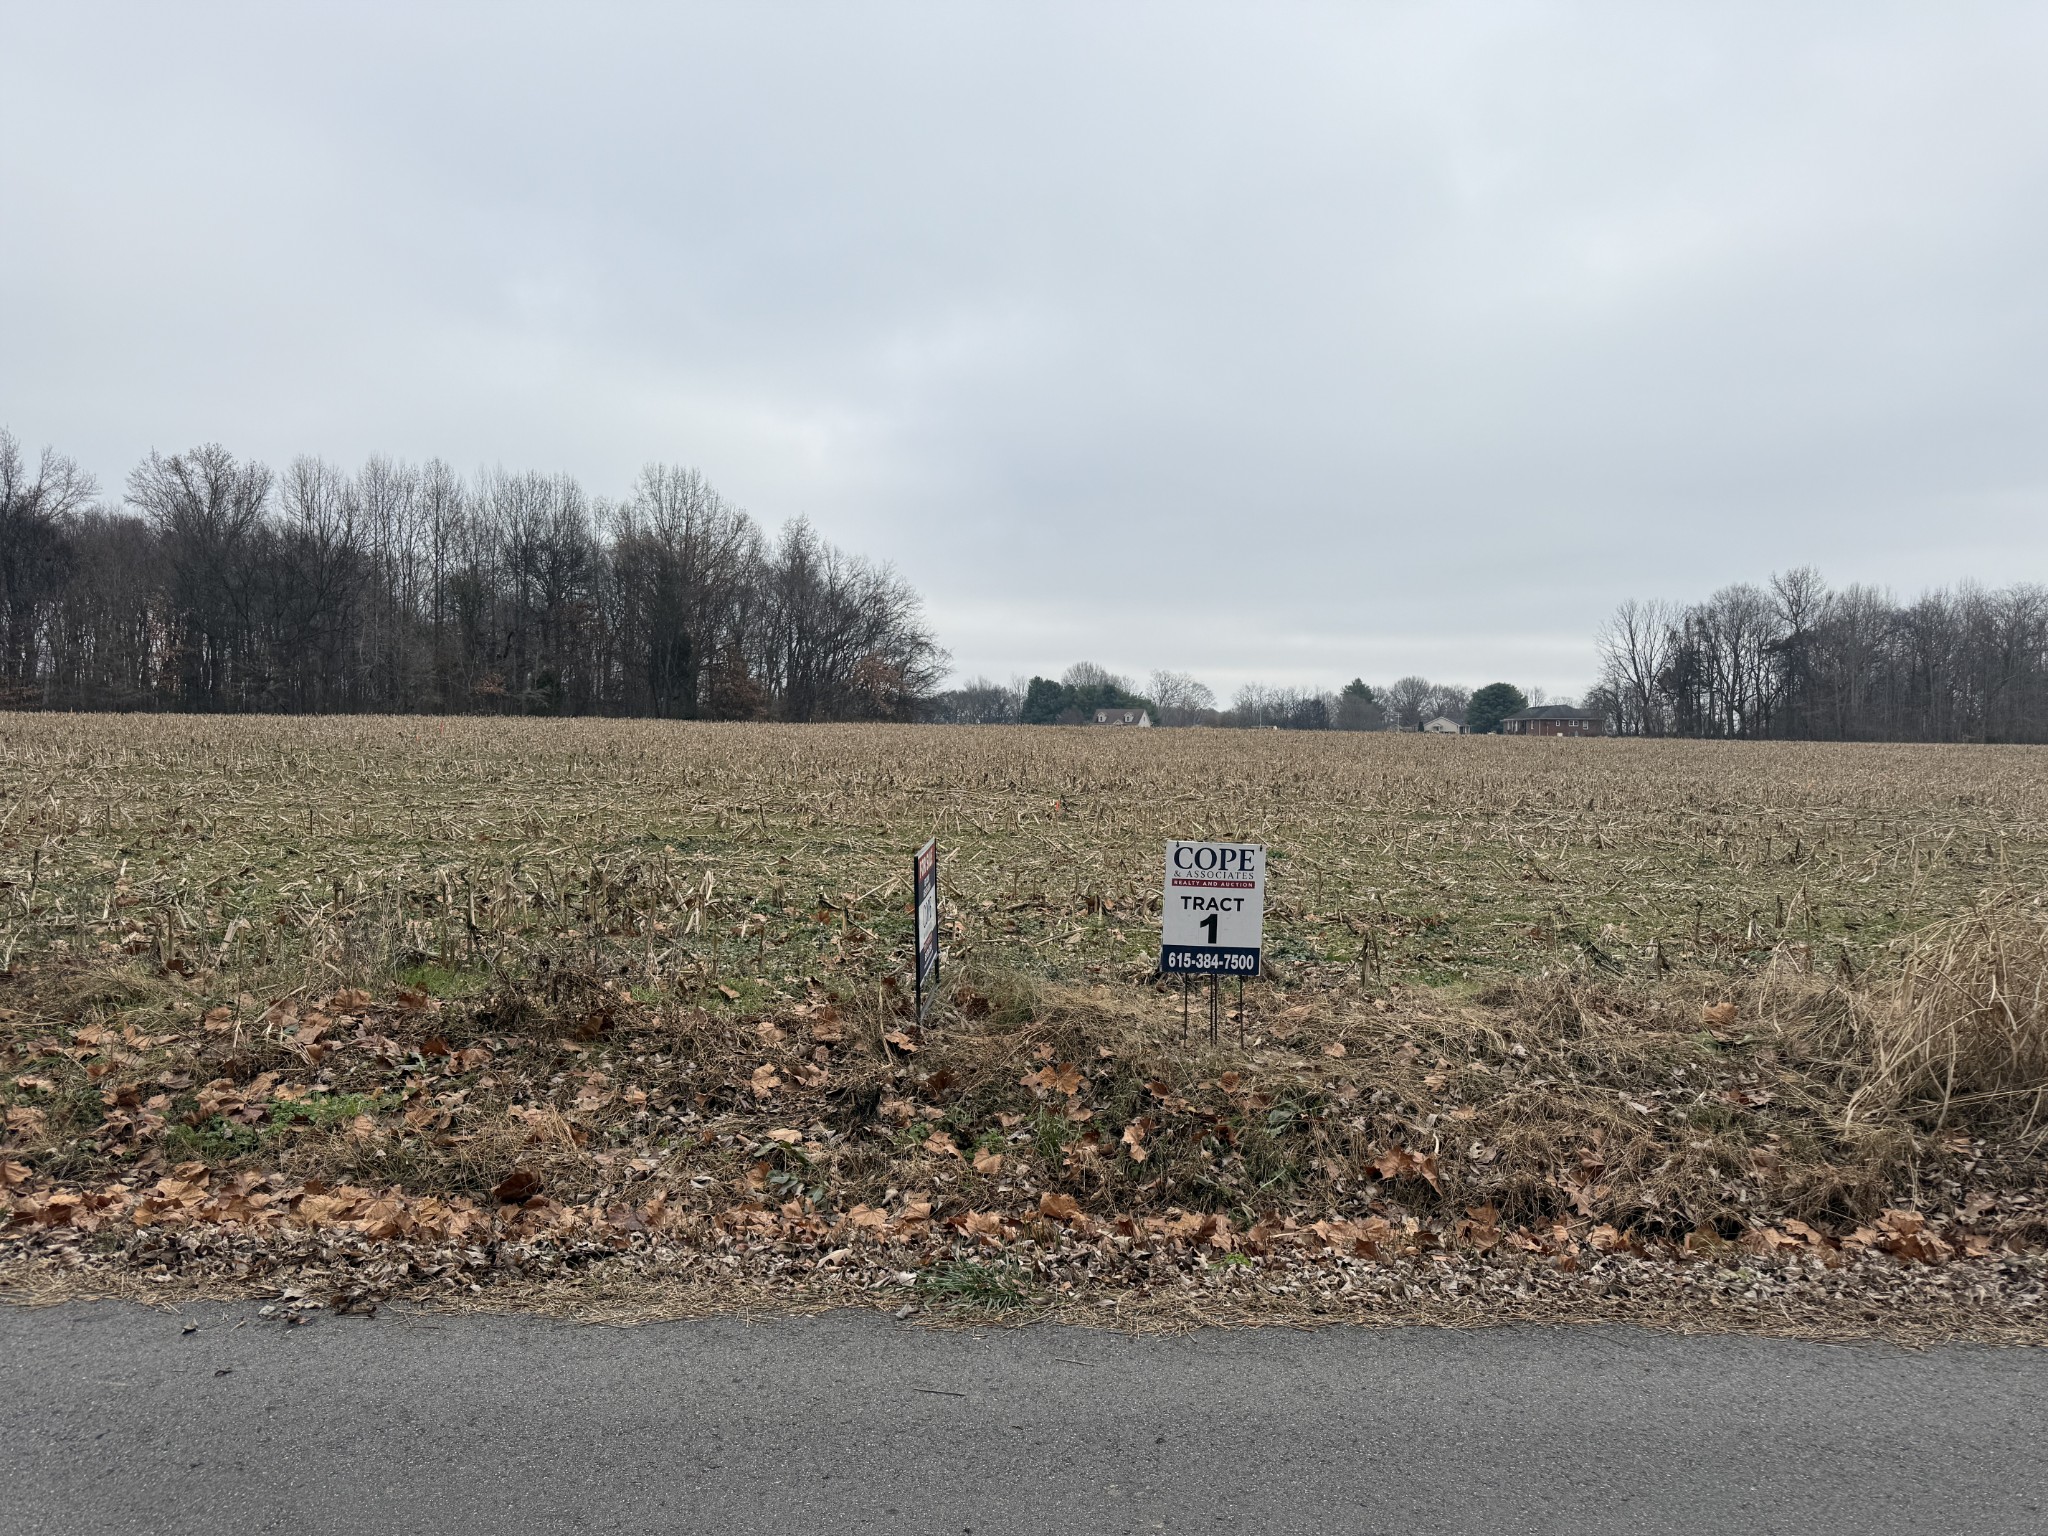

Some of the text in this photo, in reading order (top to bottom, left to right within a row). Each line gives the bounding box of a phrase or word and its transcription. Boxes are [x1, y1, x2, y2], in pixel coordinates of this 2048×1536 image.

[1174, 847, 1255, 871] COPE
[1174, 870, 1254, 880] & ASSOCIATES
[1181, 896, 1244, 911] TRACT
[1200, 914, 1218, 944] 1
[1168, 952, 1254, 970] 615-384-7500
